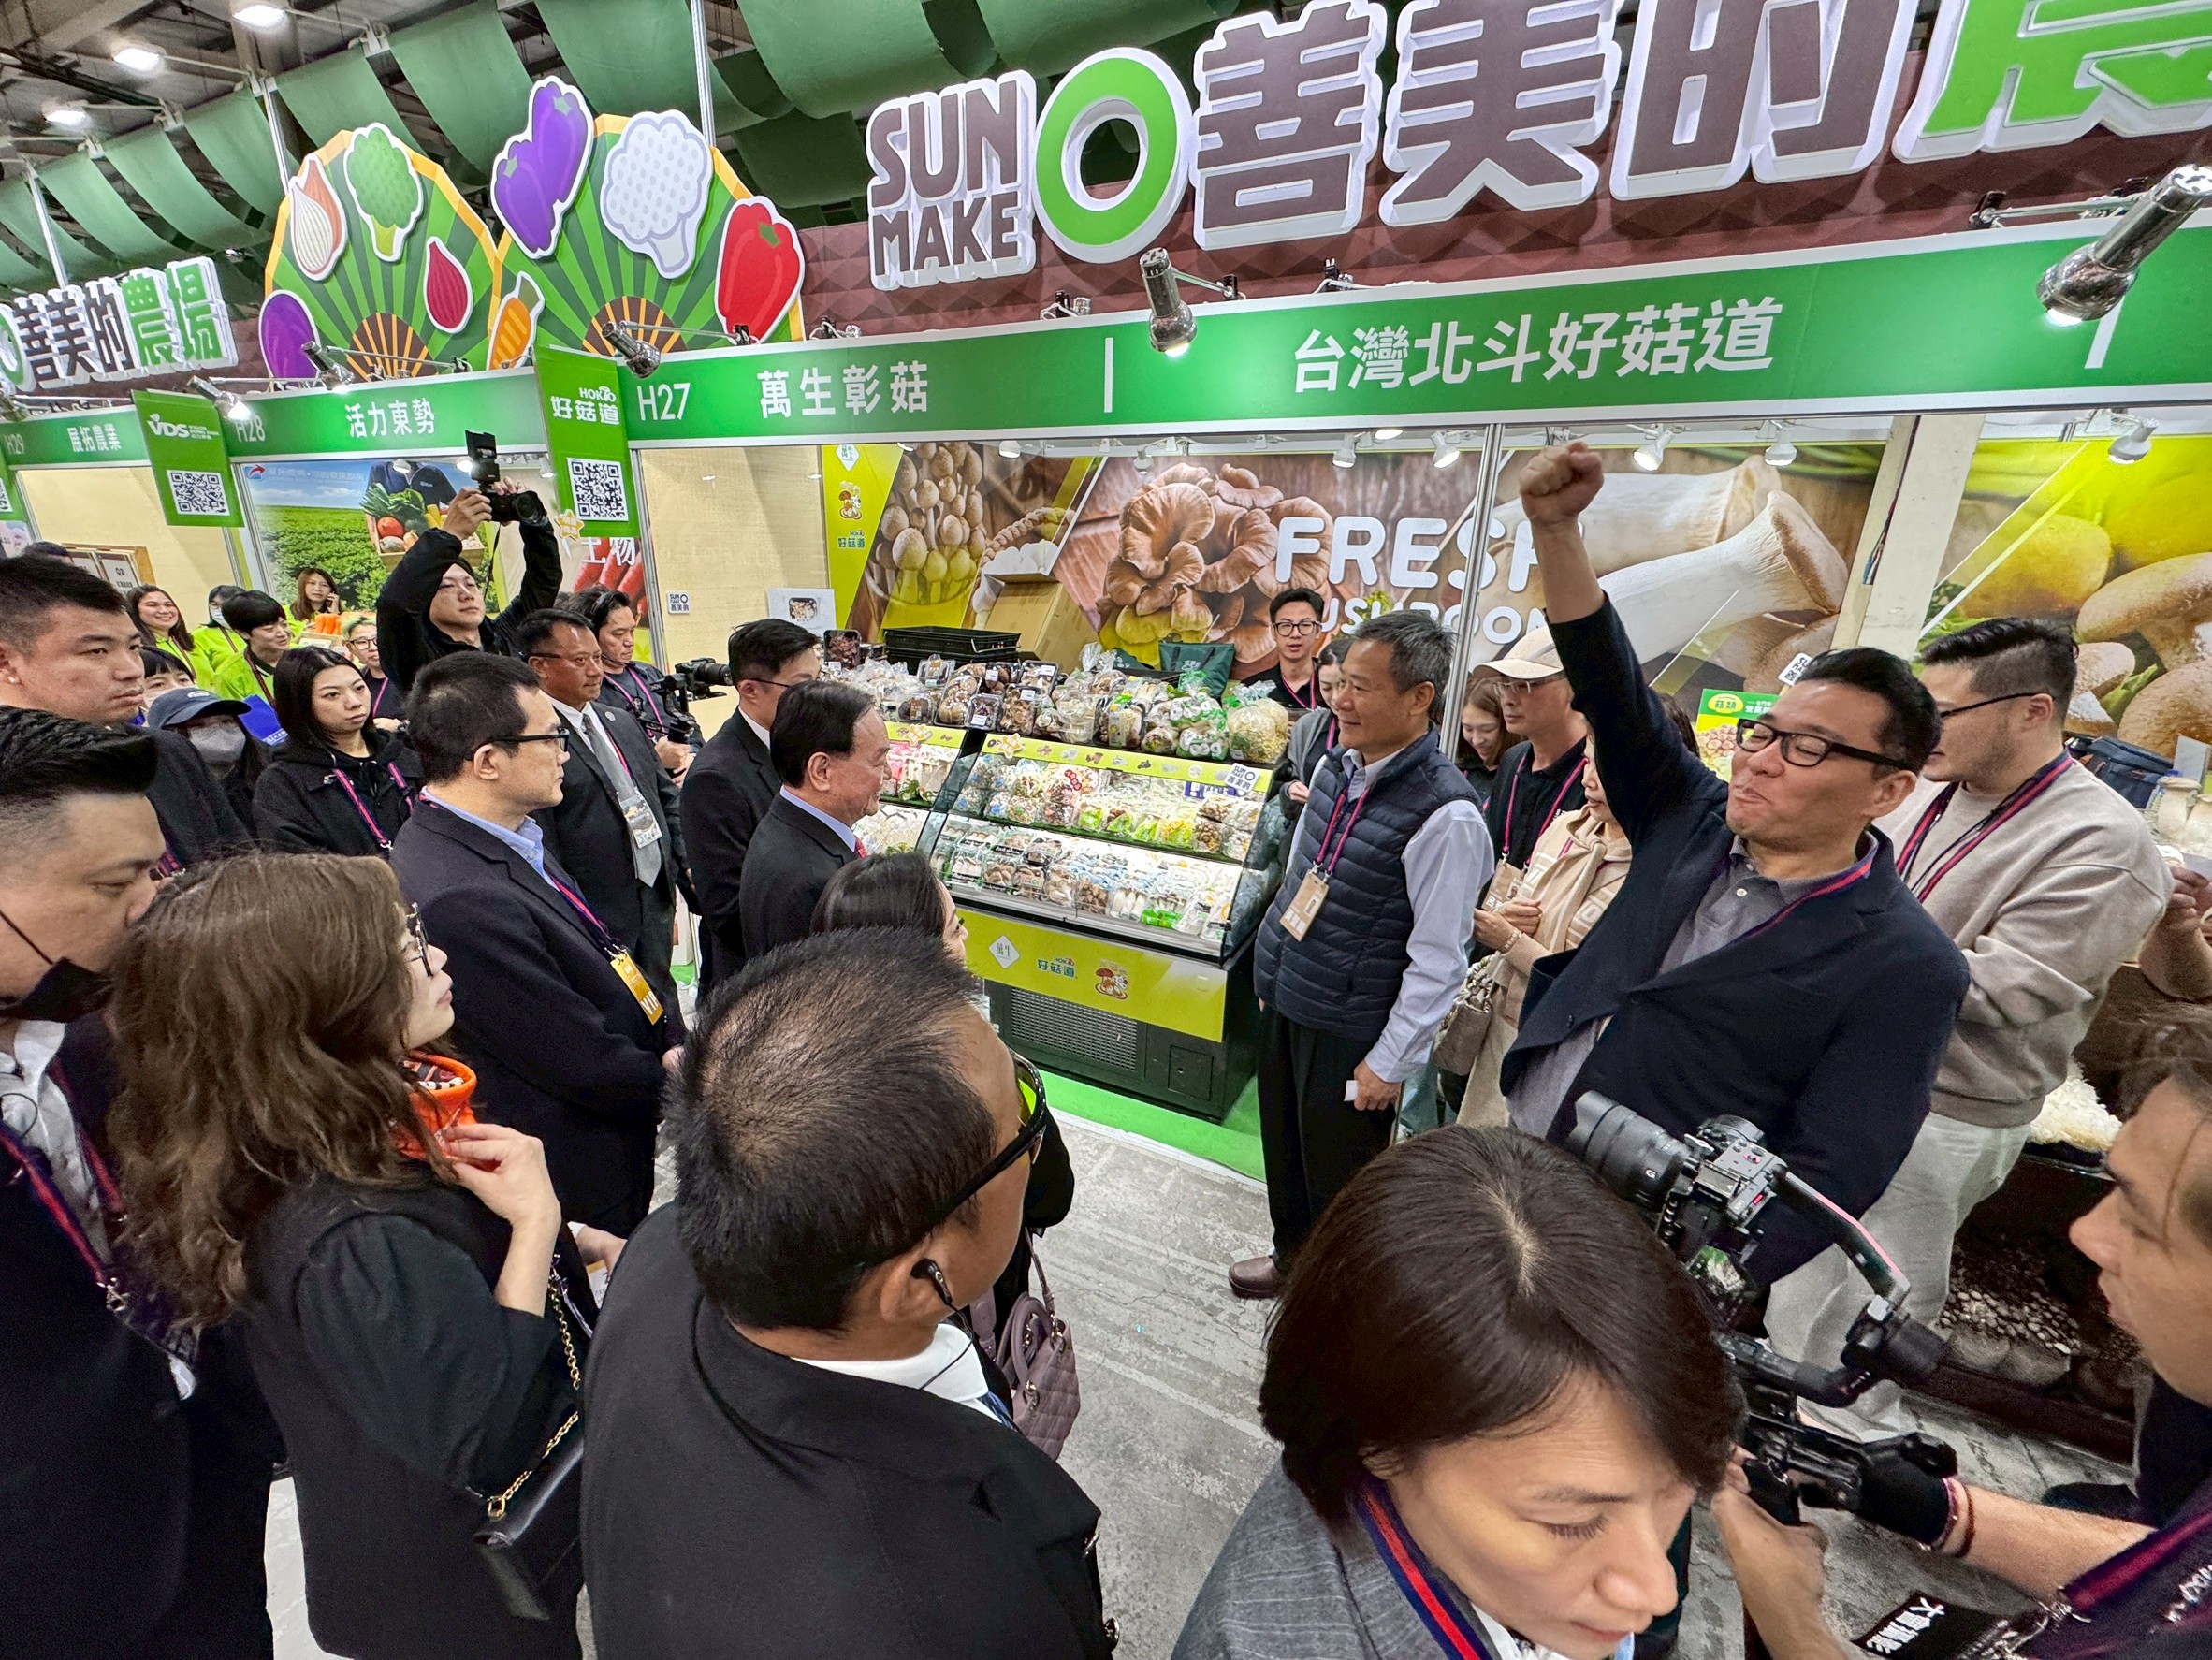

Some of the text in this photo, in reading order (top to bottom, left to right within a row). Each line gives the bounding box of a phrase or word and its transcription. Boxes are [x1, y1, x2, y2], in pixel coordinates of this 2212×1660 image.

[870, 81, 1019, 209] SUN
[871, 187, 1020, 276] MAKE
[14, 262, 224, 384] 善美的農場
[1293, 296, 1783, 394] 台灣北斗好菇道
[636, 382, 691, 421] H27
[756, 360, 929, 420] 萬生彰菇
[344, 397, 435, 438] 活力東勢
[550, 395, 620, 425] 好菇道
[4, 433, 25, 455] H29
[66, 423, 122, 453] 展拓農業
[147, 420, 190, 438] VDS
[235, 415, 266, 443] H28
[1037, 958, 1075, 978] 好菇道
[640, 990, 659, 1015] VIP
